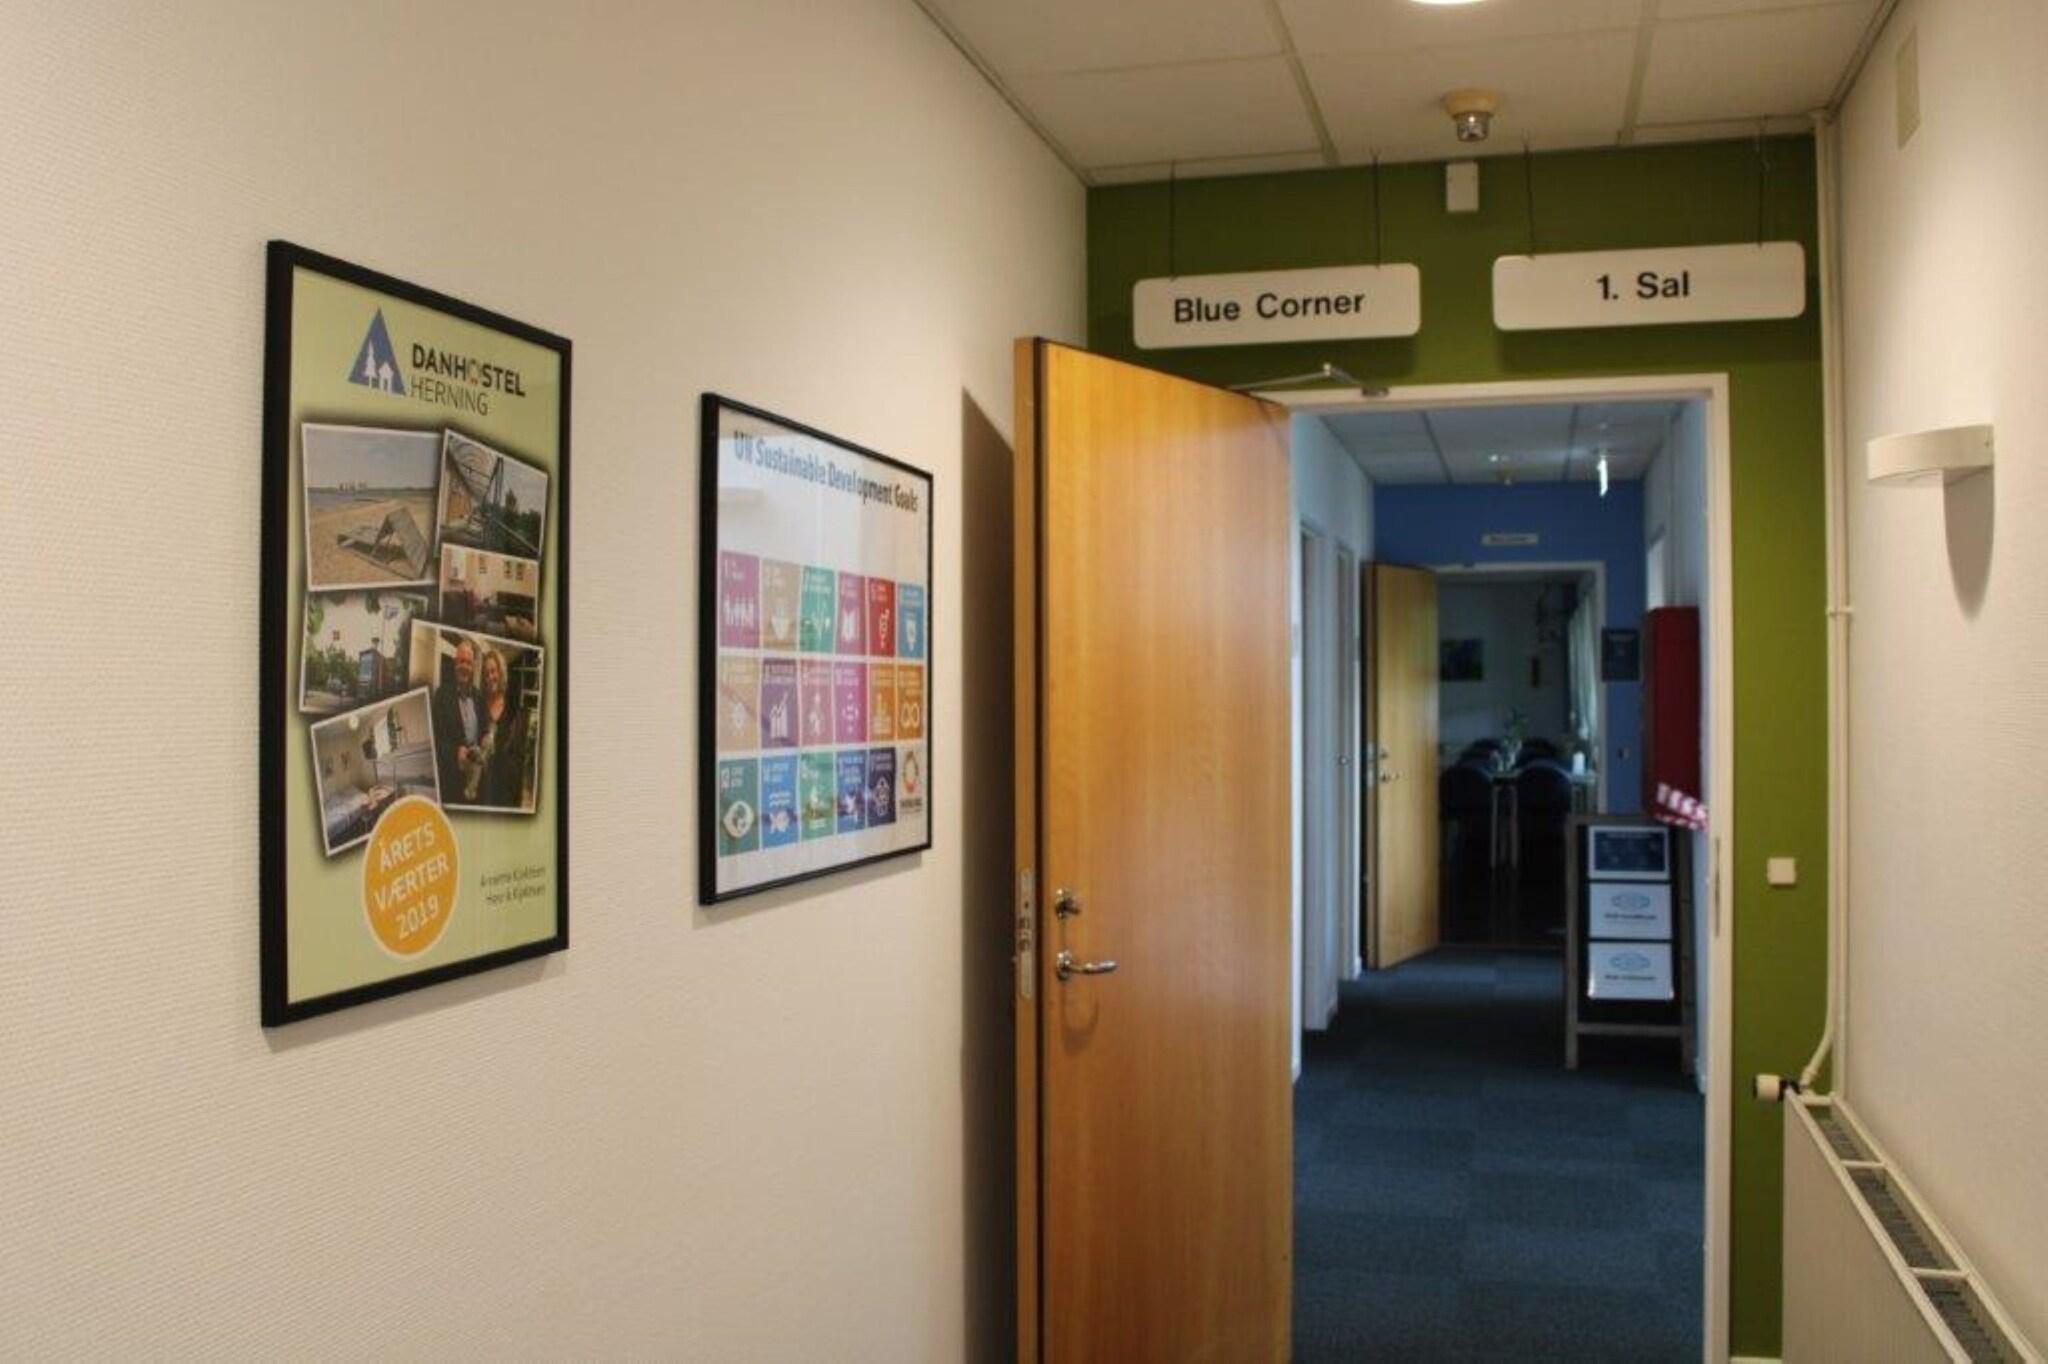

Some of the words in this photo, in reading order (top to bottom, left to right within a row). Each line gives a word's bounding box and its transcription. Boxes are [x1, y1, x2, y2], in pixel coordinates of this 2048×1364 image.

[1173, 298, 1240, 323] Blue
[1256, 290, 1365, 319] Corner
[1595, 274, 1619, 300] 1.
[1637, 270, 1689, 299] Sal
[412, 344, 525, 397] DANHOSTEL
[410, 376, 488, 416] HERNING
[755, 438, 826, 484] Sustainable
[829, 462, 893, 504] Development
[895, 484, 918, 511] Goals
[379, 821, 435, 873] ÅRETS
[374, 854, 449, 912] VÆRTER
[396, 895, 440, 940] 2019
